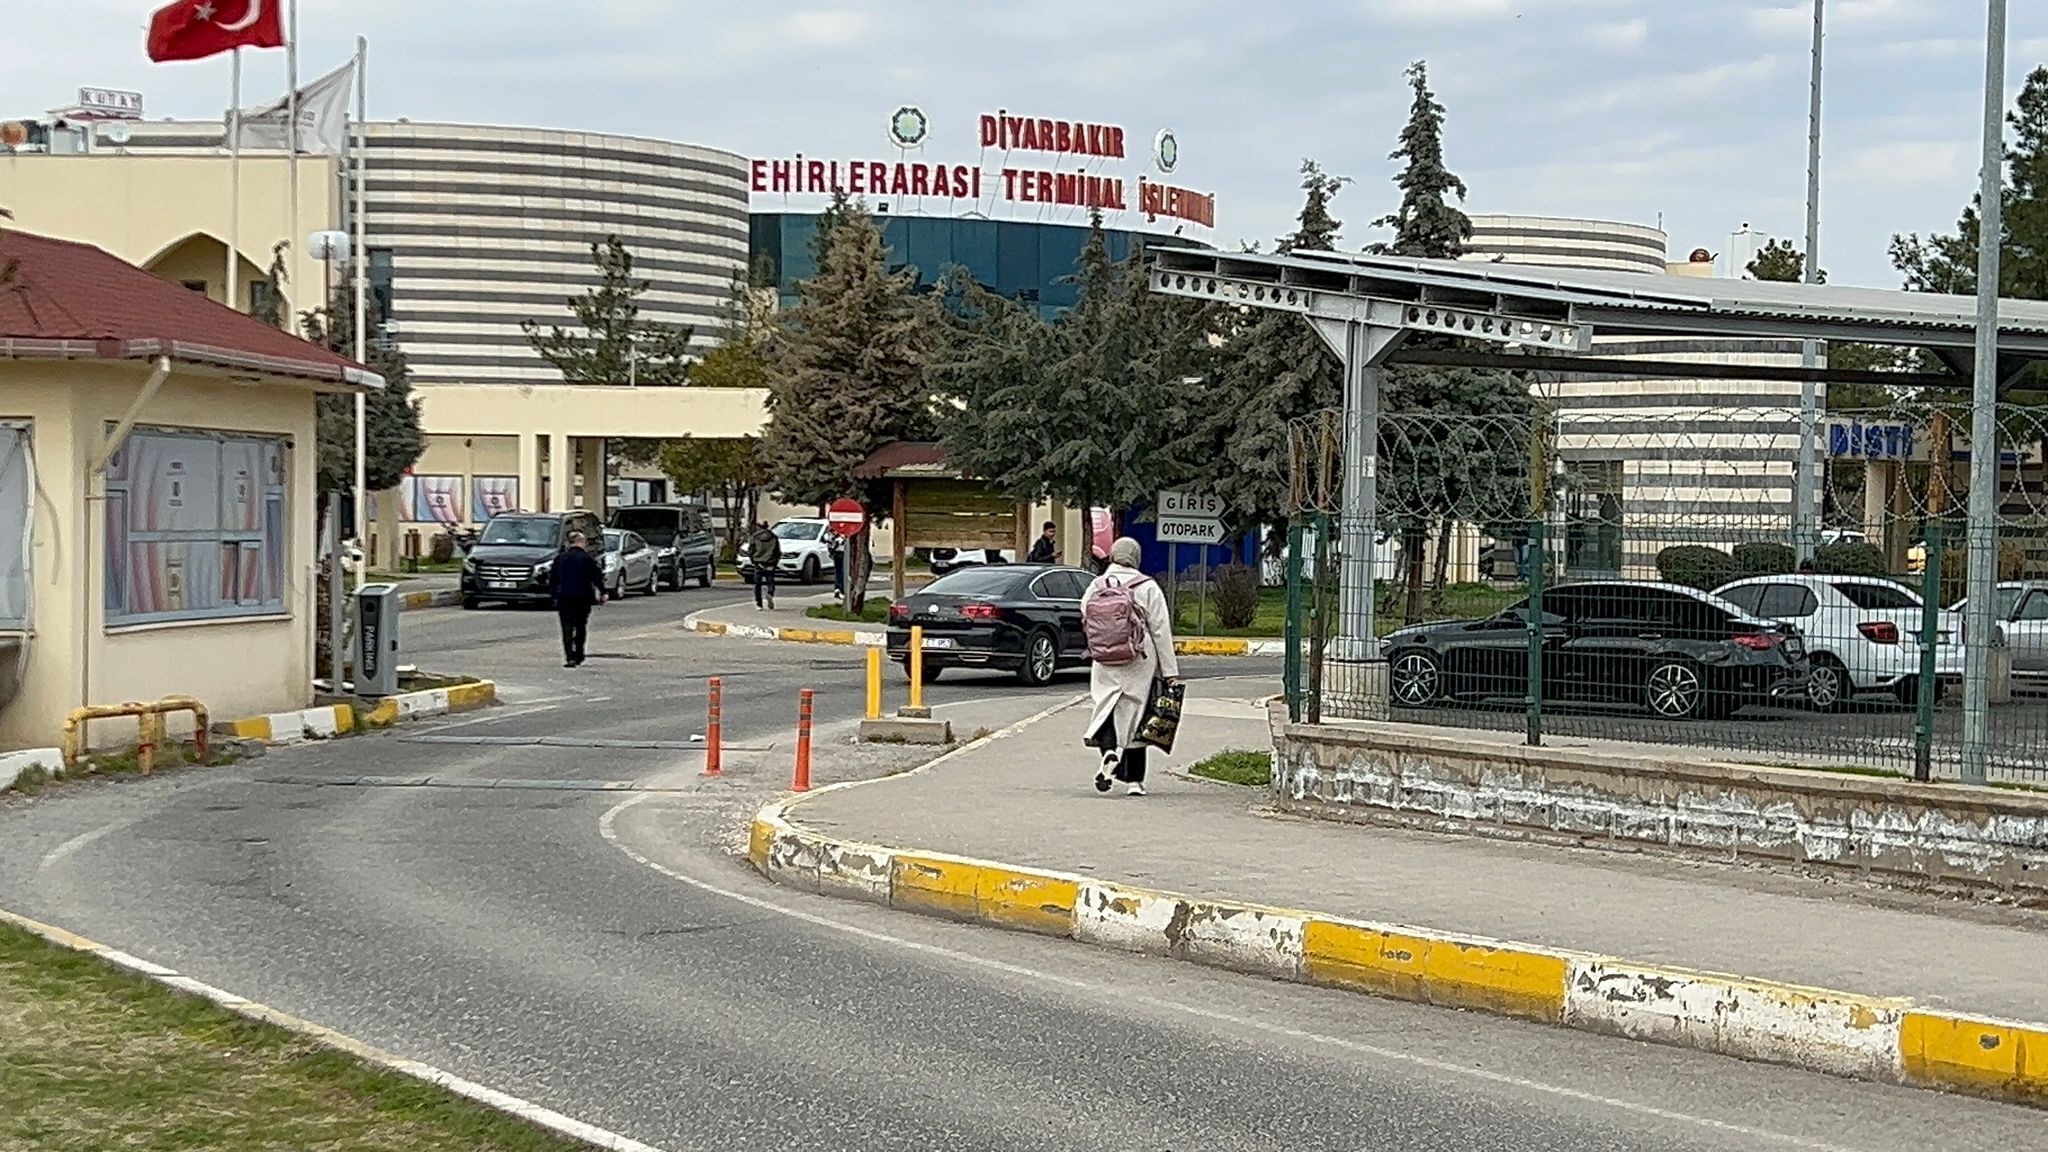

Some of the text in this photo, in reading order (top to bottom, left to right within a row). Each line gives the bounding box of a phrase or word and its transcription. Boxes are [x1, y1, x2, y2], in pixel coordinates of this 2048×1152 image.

[981, 109, 1124, 158] DİYARBAKIR
[1002, 168, 1126, 210] TERMİNAL
[1138, 176, 1214, 228] İŞLETİ
[1162, 522, 1216, 537] OTOPARK
